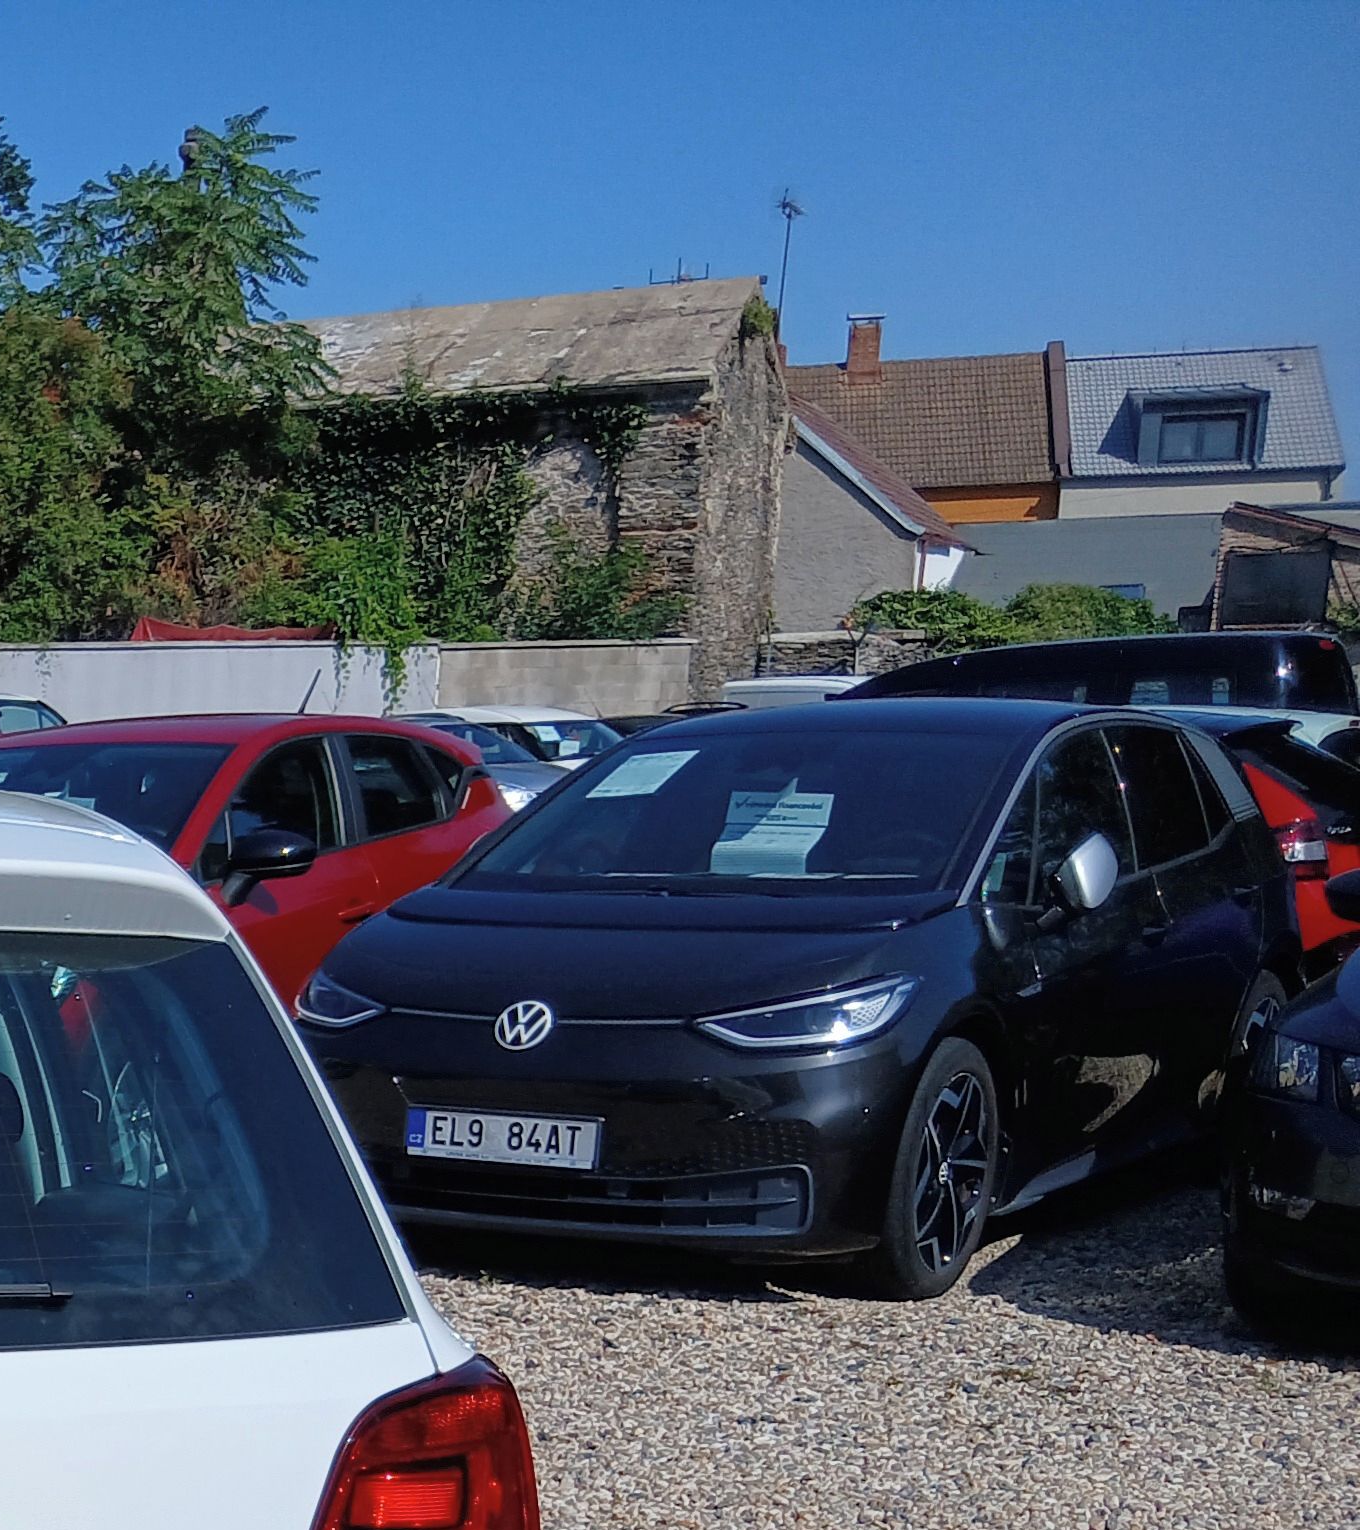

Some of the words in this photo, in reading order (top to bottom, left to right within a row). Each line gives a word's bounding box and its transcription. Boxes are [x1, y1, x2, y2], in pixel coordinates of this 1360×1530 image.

[409, 1133, 423, 1143] CZ
[431, 1116, 484, 1148] EL9
[507, 1121, 582, 1157] 84AT
